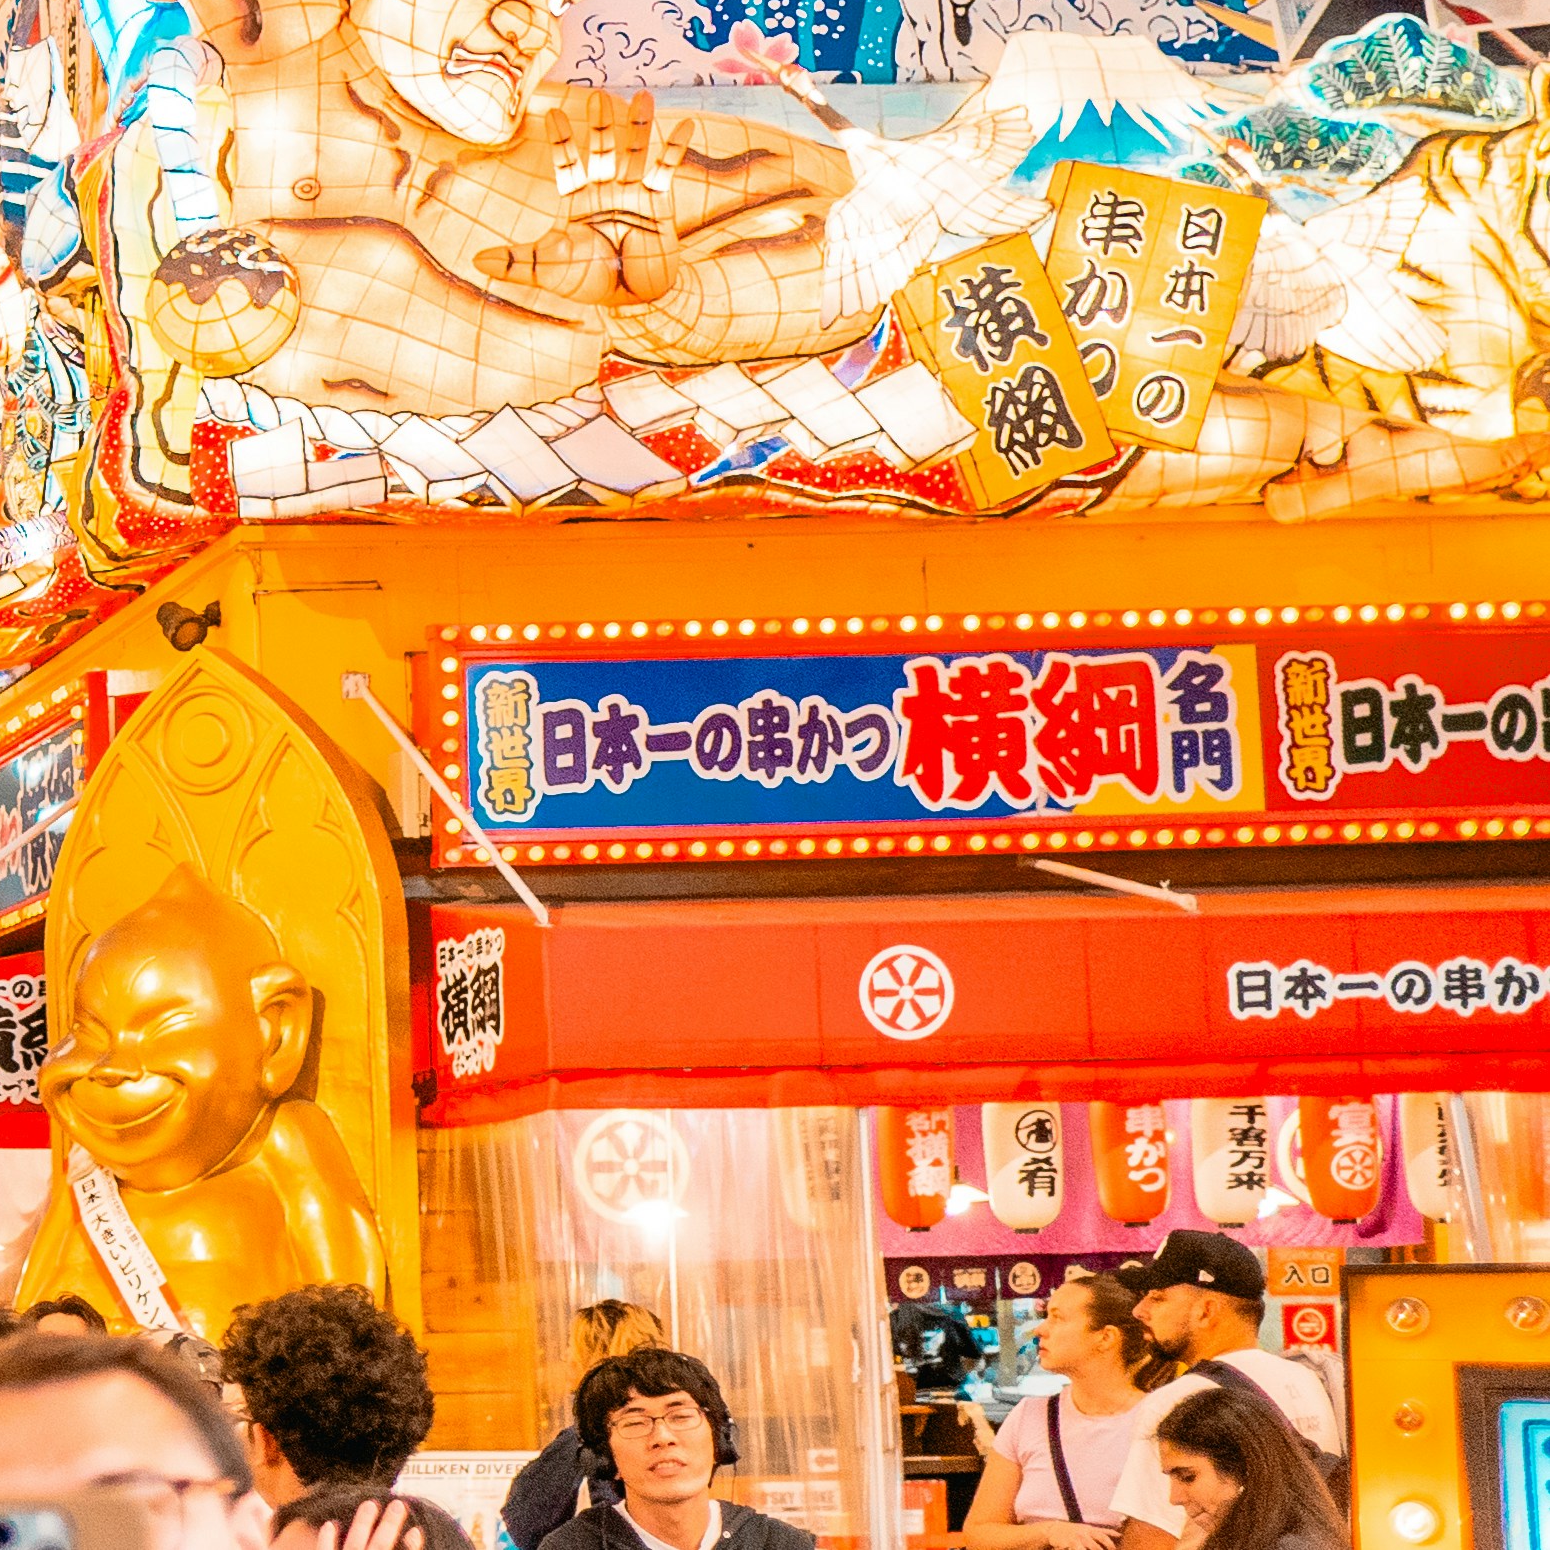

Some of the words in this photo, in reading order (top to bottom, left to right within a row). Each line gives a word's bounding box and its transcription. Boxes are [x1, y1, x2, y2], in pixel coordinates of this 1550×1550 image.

[941, 266, 1084, 477] 横綱
[483, 678, 536, 816] 新世界
[542, 697, 892, 787] 日本一の串かつ
[900, 660, 1157, 803] 横綱
[1166, 659, 1232, 793] 名門
[1281, 656, 1334, 794] 新世界
[1235, 963, 1550, 1013] 日本一の串か
[1226, 1104, 1267, 1191] 千客万来
[1284, 1265, 1330, 1284] 入口
